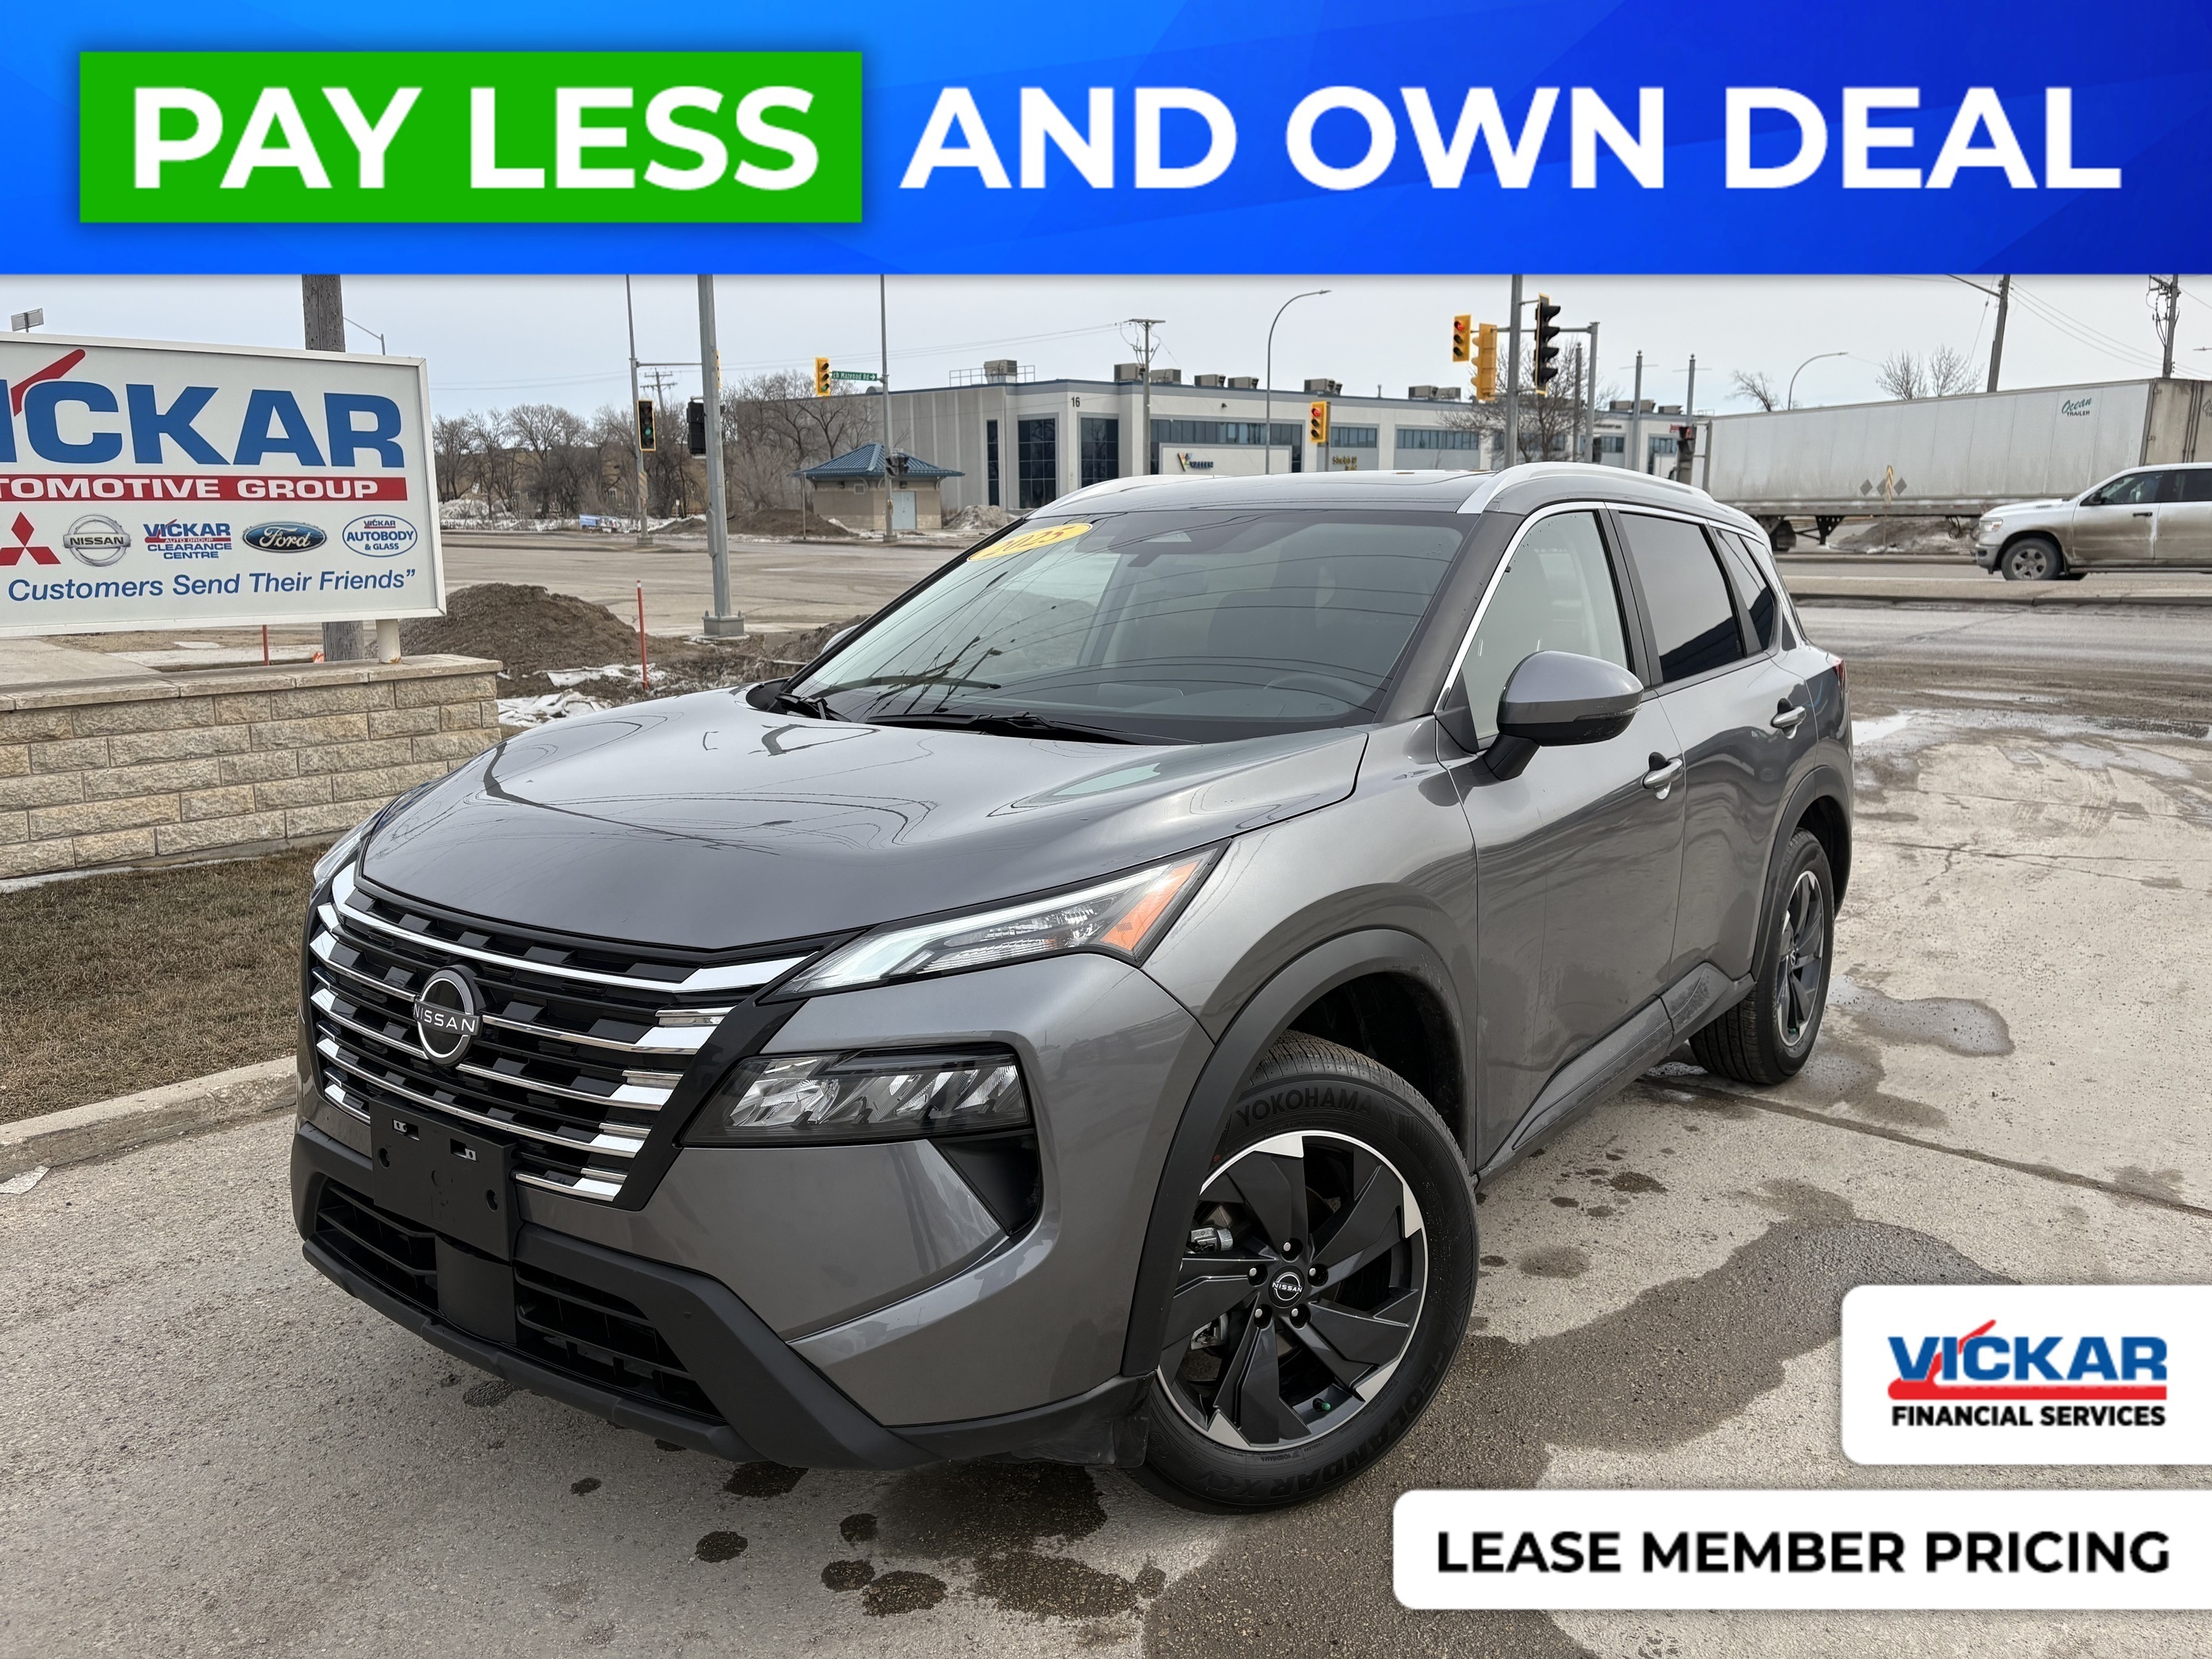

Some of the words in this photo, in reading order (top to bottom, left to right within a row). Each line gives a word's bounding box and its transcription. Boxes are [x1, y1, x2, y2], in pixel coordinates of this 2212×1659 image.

[1071, 396, 1081, 408] 16
[2061, 398, 2092, 414] Ocean
[237, 478, 379, 499] GROUP
[143, 523, 231, 537] VICKAR
[259, 527, 311, 548] Ford
[346, 531, 414, 541] AUTOBODY
[70, 537, 124, 545] NISSAN
[147, 543, 233, 551] CLEARANCE
[981, 526, 1076, 558] 2025
[8, 578, 164, 601] Customers
[173, 574, 240, 595] Send
[249, 571, 312, 592] Their
[413, 1003, 475, 1033] NISSAN
[1236, 1087, 1373, 1127] YOKOHAMA
[1272, 1282, 1303, 1293] NISSAN
